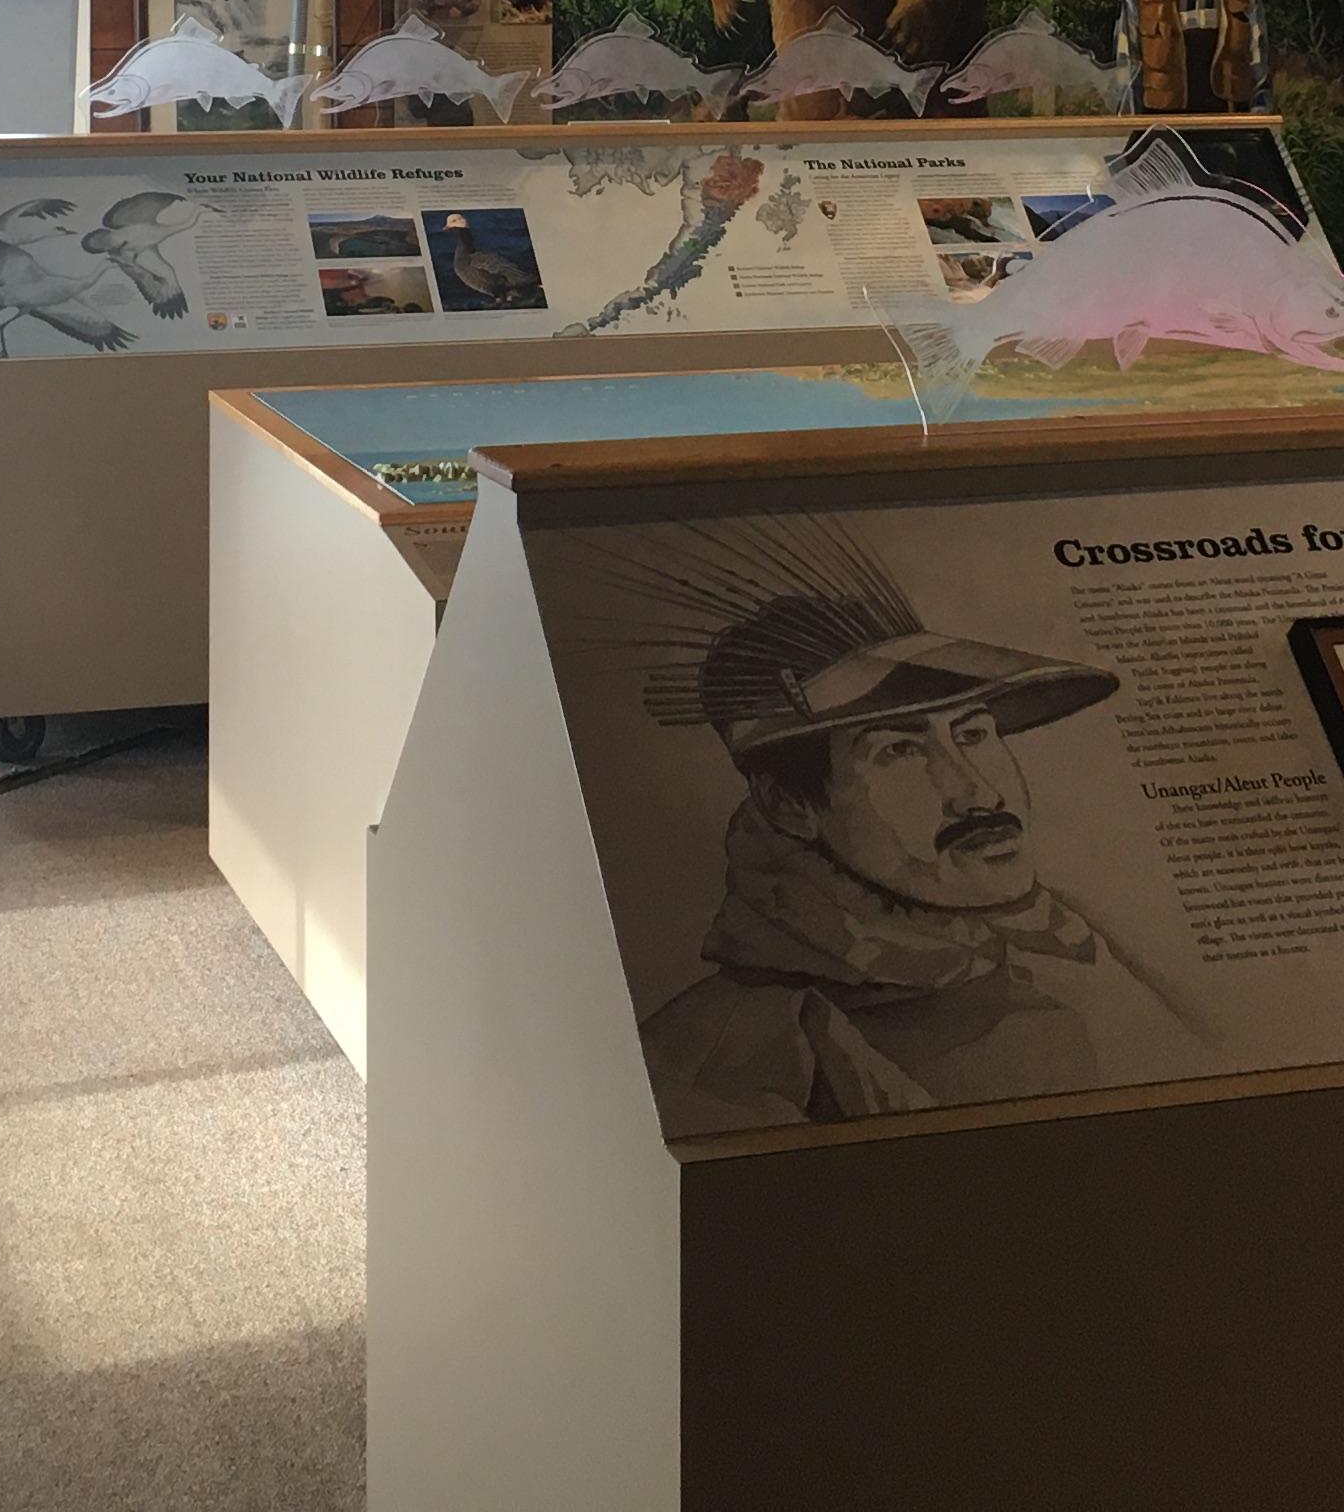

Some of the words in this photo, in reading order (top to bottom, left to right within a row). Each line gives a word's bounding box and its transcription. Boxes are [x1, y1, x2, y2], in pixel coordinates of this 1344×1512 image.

[804, 159, 836, 171] The
[840, 157, 913, 170] National
[917, 156, 966, 169] Parks
[184, 171, 227, 184] Your
[232, 169, 313, 183] National
[316, 168, 386, 181] Wildlife
[391, 167, 464, 182] Refuges
[1053, 527, 1295, 569] Crossroads
[1271, 769, 1328, 791] People
